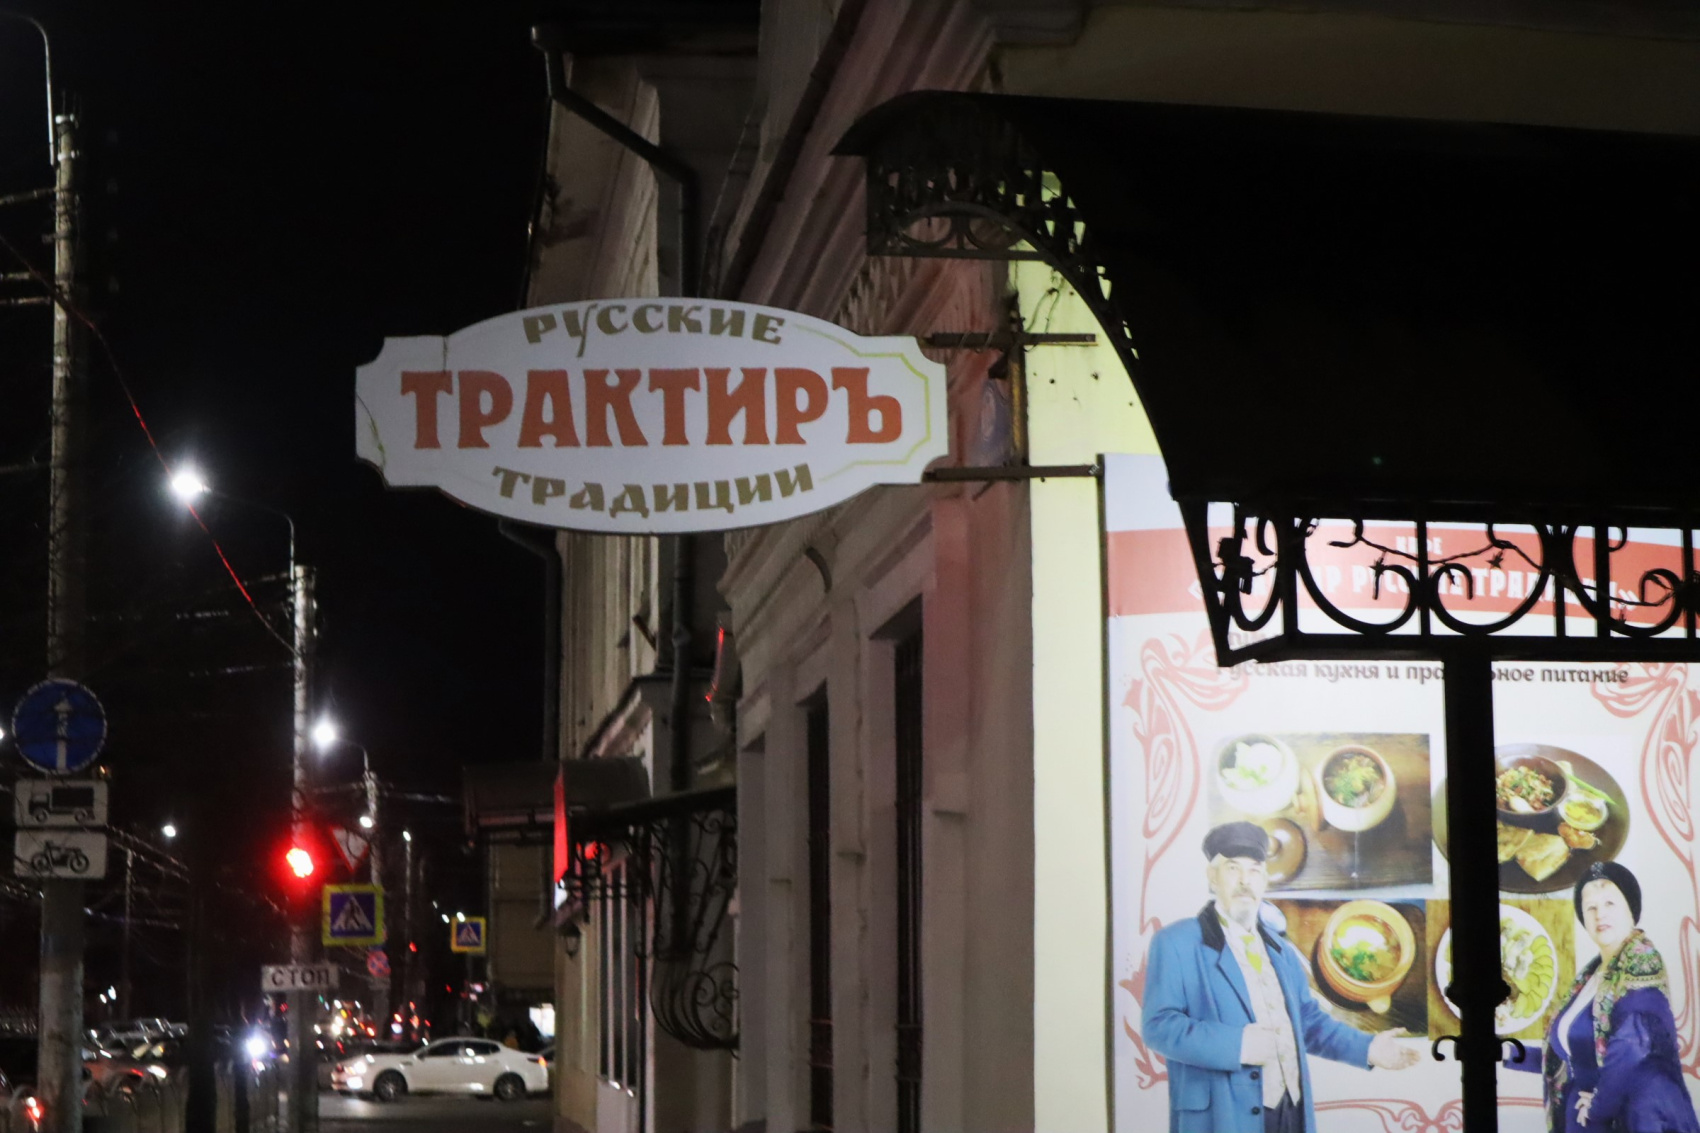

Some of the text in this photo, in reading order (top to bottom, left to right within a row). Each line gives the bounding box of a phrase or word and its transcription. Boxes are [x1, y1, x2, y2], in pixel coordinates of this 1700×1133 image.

[522, 303, 785, 357] РУССКИЕ
[400, 366, 902, 450] ТРАКТИРЪ
[491, 462, 814, 518] ТРАДИЦИИ
[1387, 664, 1399, 679] и
[1541, 668, 1629, 683] питание
